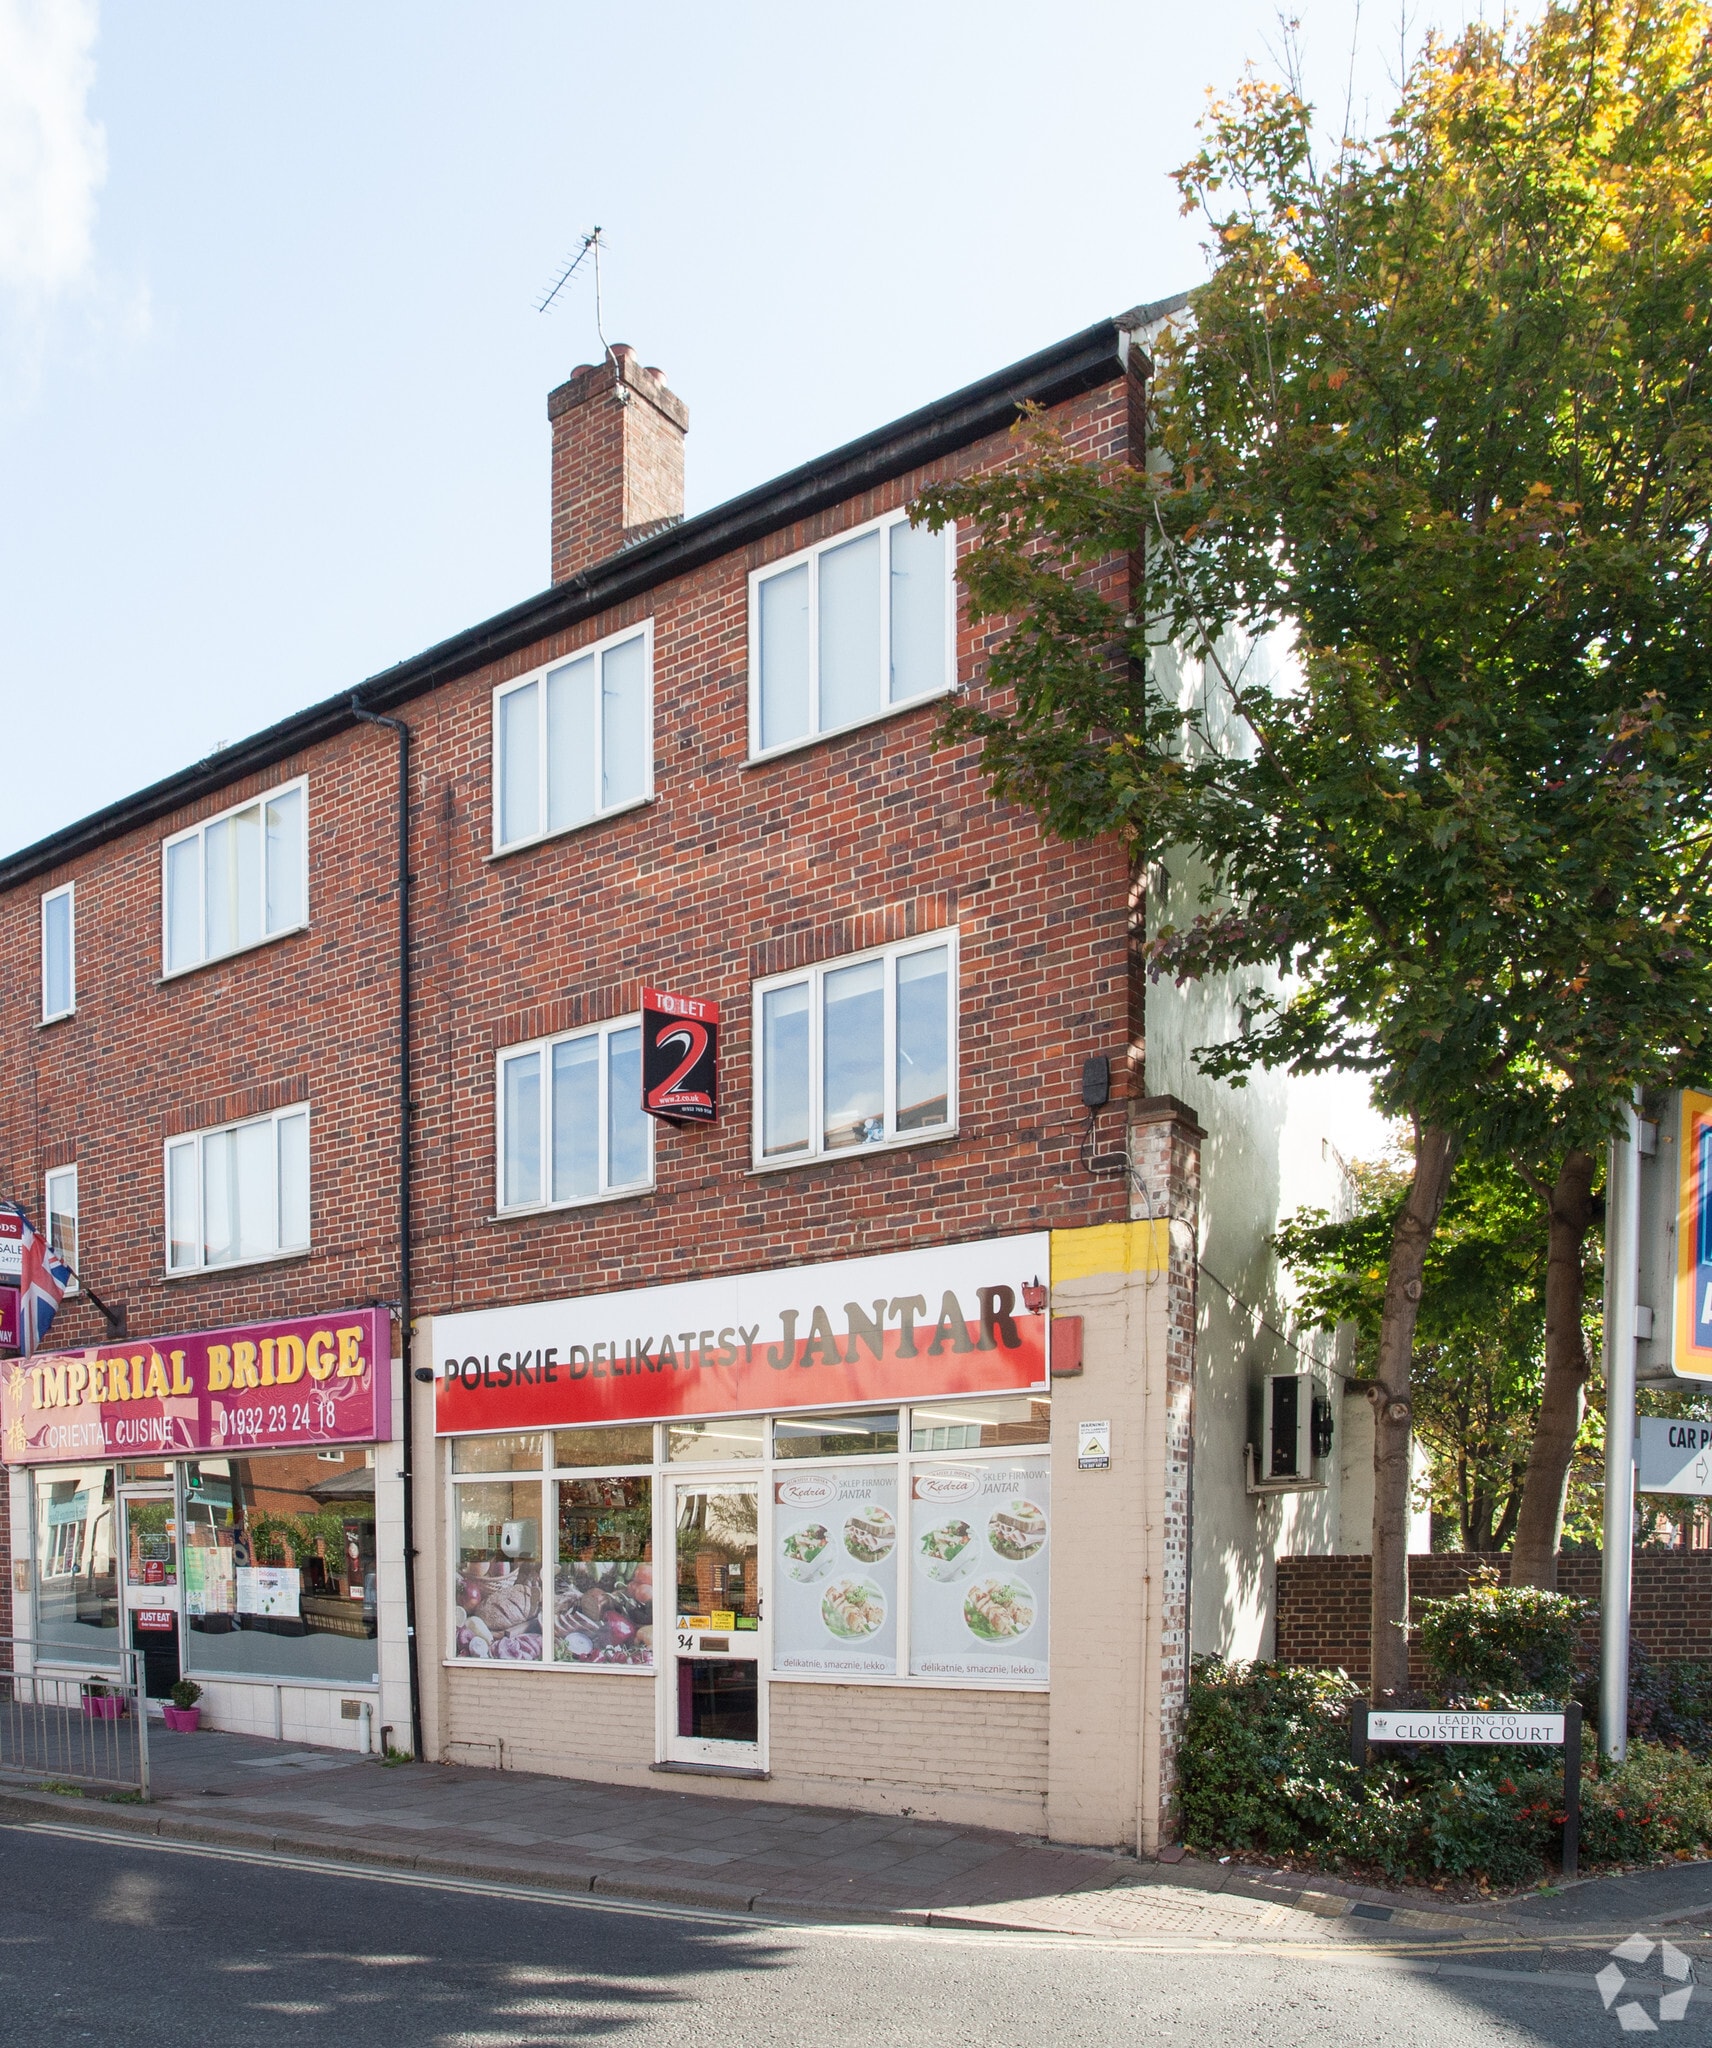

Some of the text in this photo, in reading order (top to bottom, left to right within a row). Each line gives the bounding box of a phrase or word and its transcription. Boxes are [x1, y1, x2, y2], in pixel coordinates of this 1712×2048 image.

[655, 993, 706, 1017] TO LET
[767, 1284, 1022, 1370] JANTAR
[444, 1323, 760, 1393] POLSKIE DELIKATESY
[31, 1325, 367, 1411] IMPERIAL BRIDGE
[219, 1400, 335, 1436] 01932 23 24 18
[49, 1416, 173, 1449] ORIENTAL CUISINE
[1668, 1425, 1697, 1449] CAR
[839, 1479, 861, 1488] SKLEP
[982, 1470, 1048, 1482] SKLEP FIRMOWY
[837, 1488, 872, 1501] JANTAR
[981, 1481, 1020, 1495] JANTAR
[140, 1612, 170, 1622] JUST EAT
[677, 1634, 694, 1651] 34
[783, 1658, 886, 1671] delikatnie, smacznie, lekko
[920, 1662, 1035, 1675] delikatnie, smacznie, lekko
[1437, 1715, 1517, 1726] LEADING TO
[1395, 1724, 1554, 1741] CLOISTER COURT
